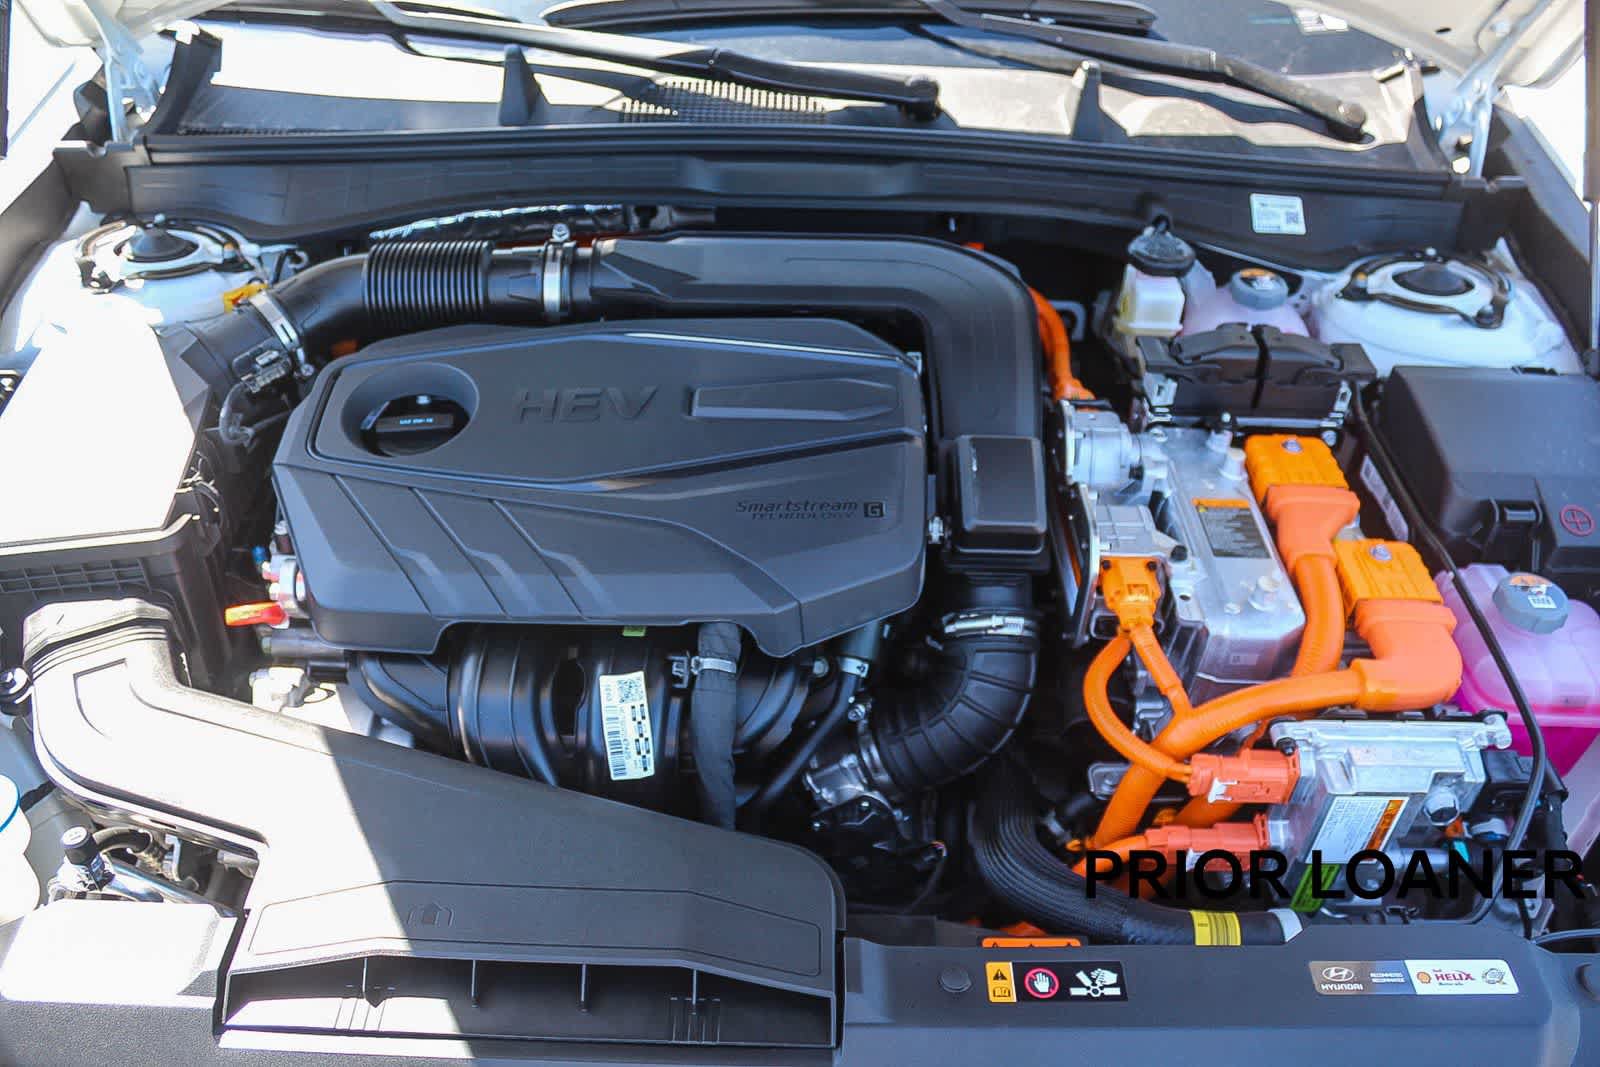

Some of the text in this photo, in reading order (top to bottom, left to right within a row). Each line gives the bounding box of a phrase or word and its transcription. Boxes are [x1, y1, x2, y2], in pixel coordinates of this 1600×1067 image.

[512, 387, 659, 425] HEV
[736, 499, 858, 513] Smartstream
[1435, 972, 1475, 981] HELIX
[1321, 983, 1364, 991] HYUNDAI
